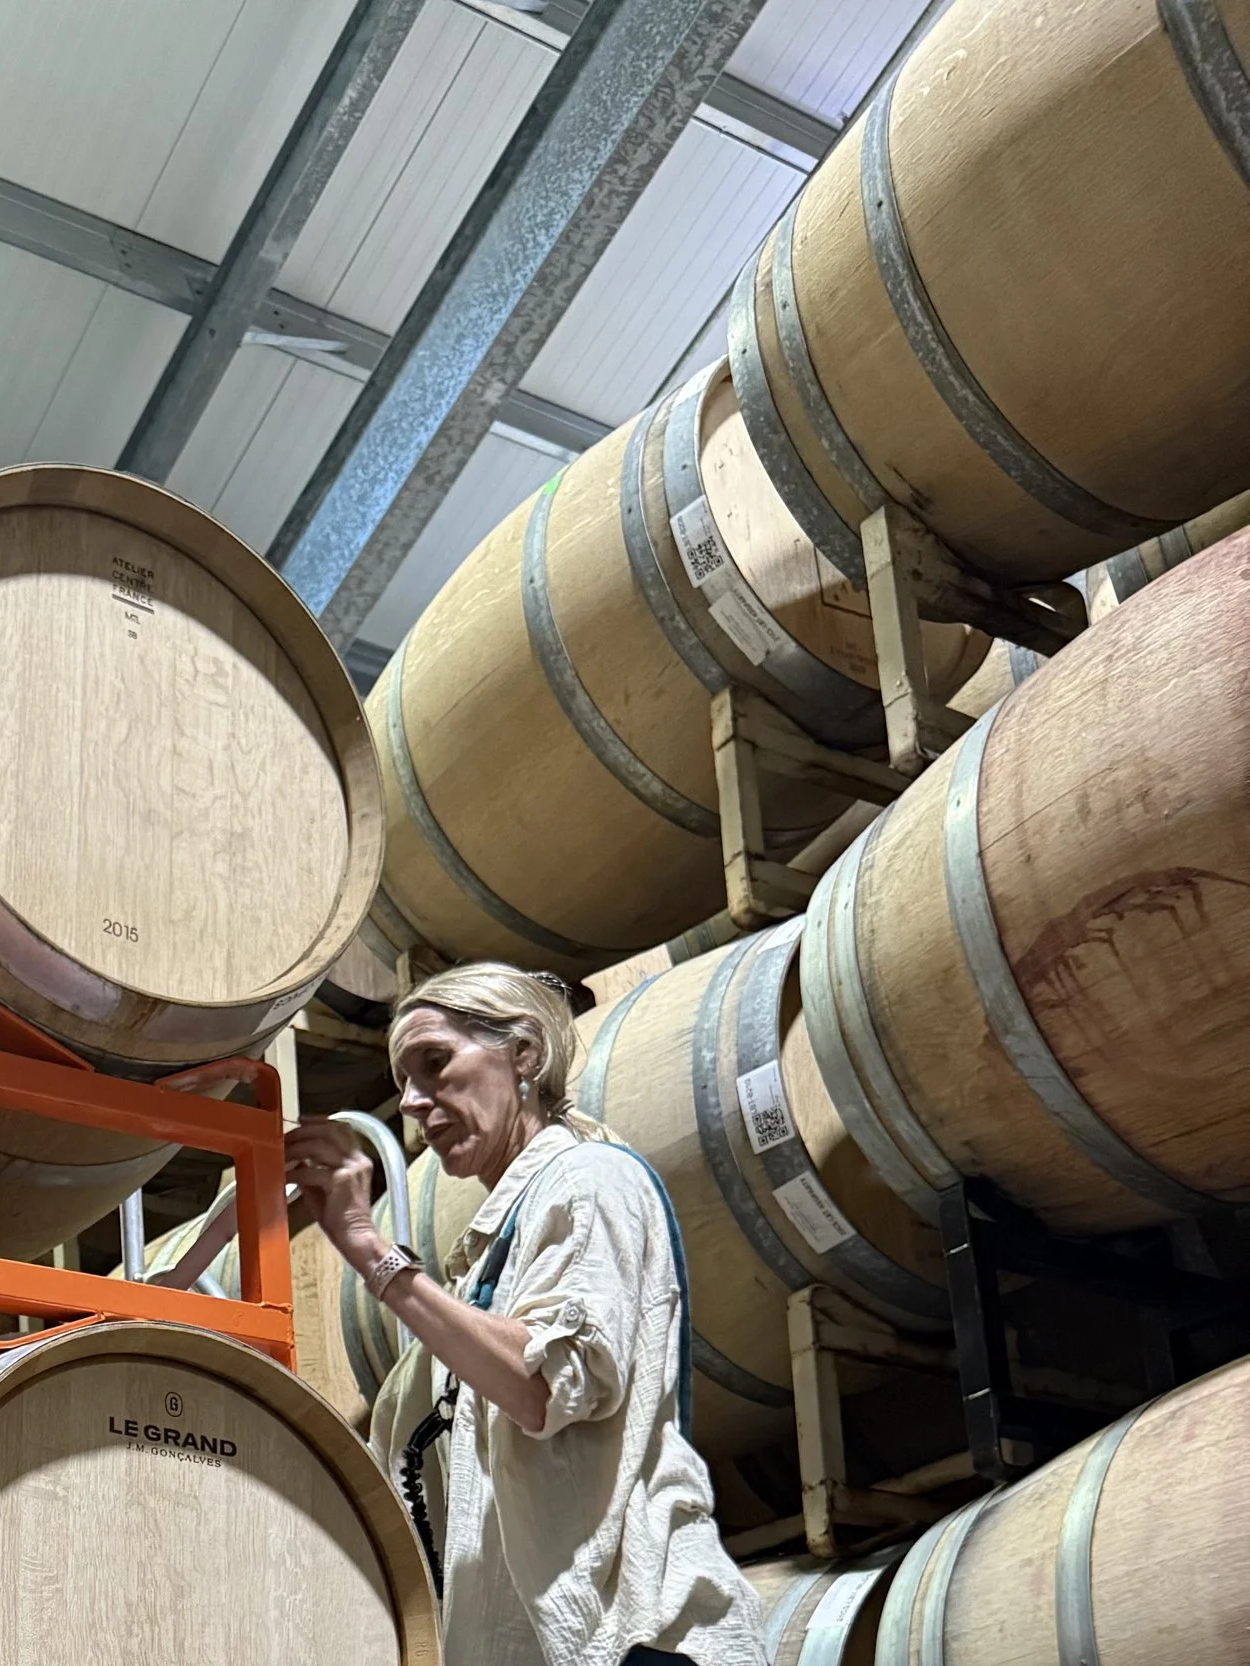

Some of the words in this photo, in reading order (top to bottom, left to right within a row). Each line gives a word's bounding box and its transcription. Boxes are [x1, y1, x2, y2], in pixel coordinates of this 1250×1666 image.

[112, 556, 154, 579] ATELIER
[112, 570, 155, 594] CENTRE
[113, 583, 154, 607] FRANCE
[103, 918, 139, 943] 2015
[108, 1416, 139, 1438] LE
[143, 1424, 237, 1457] GRAND
[126, 1442, 148, 1454] J.M.
[151, 1446, 221, 1468] GONÇALVES
